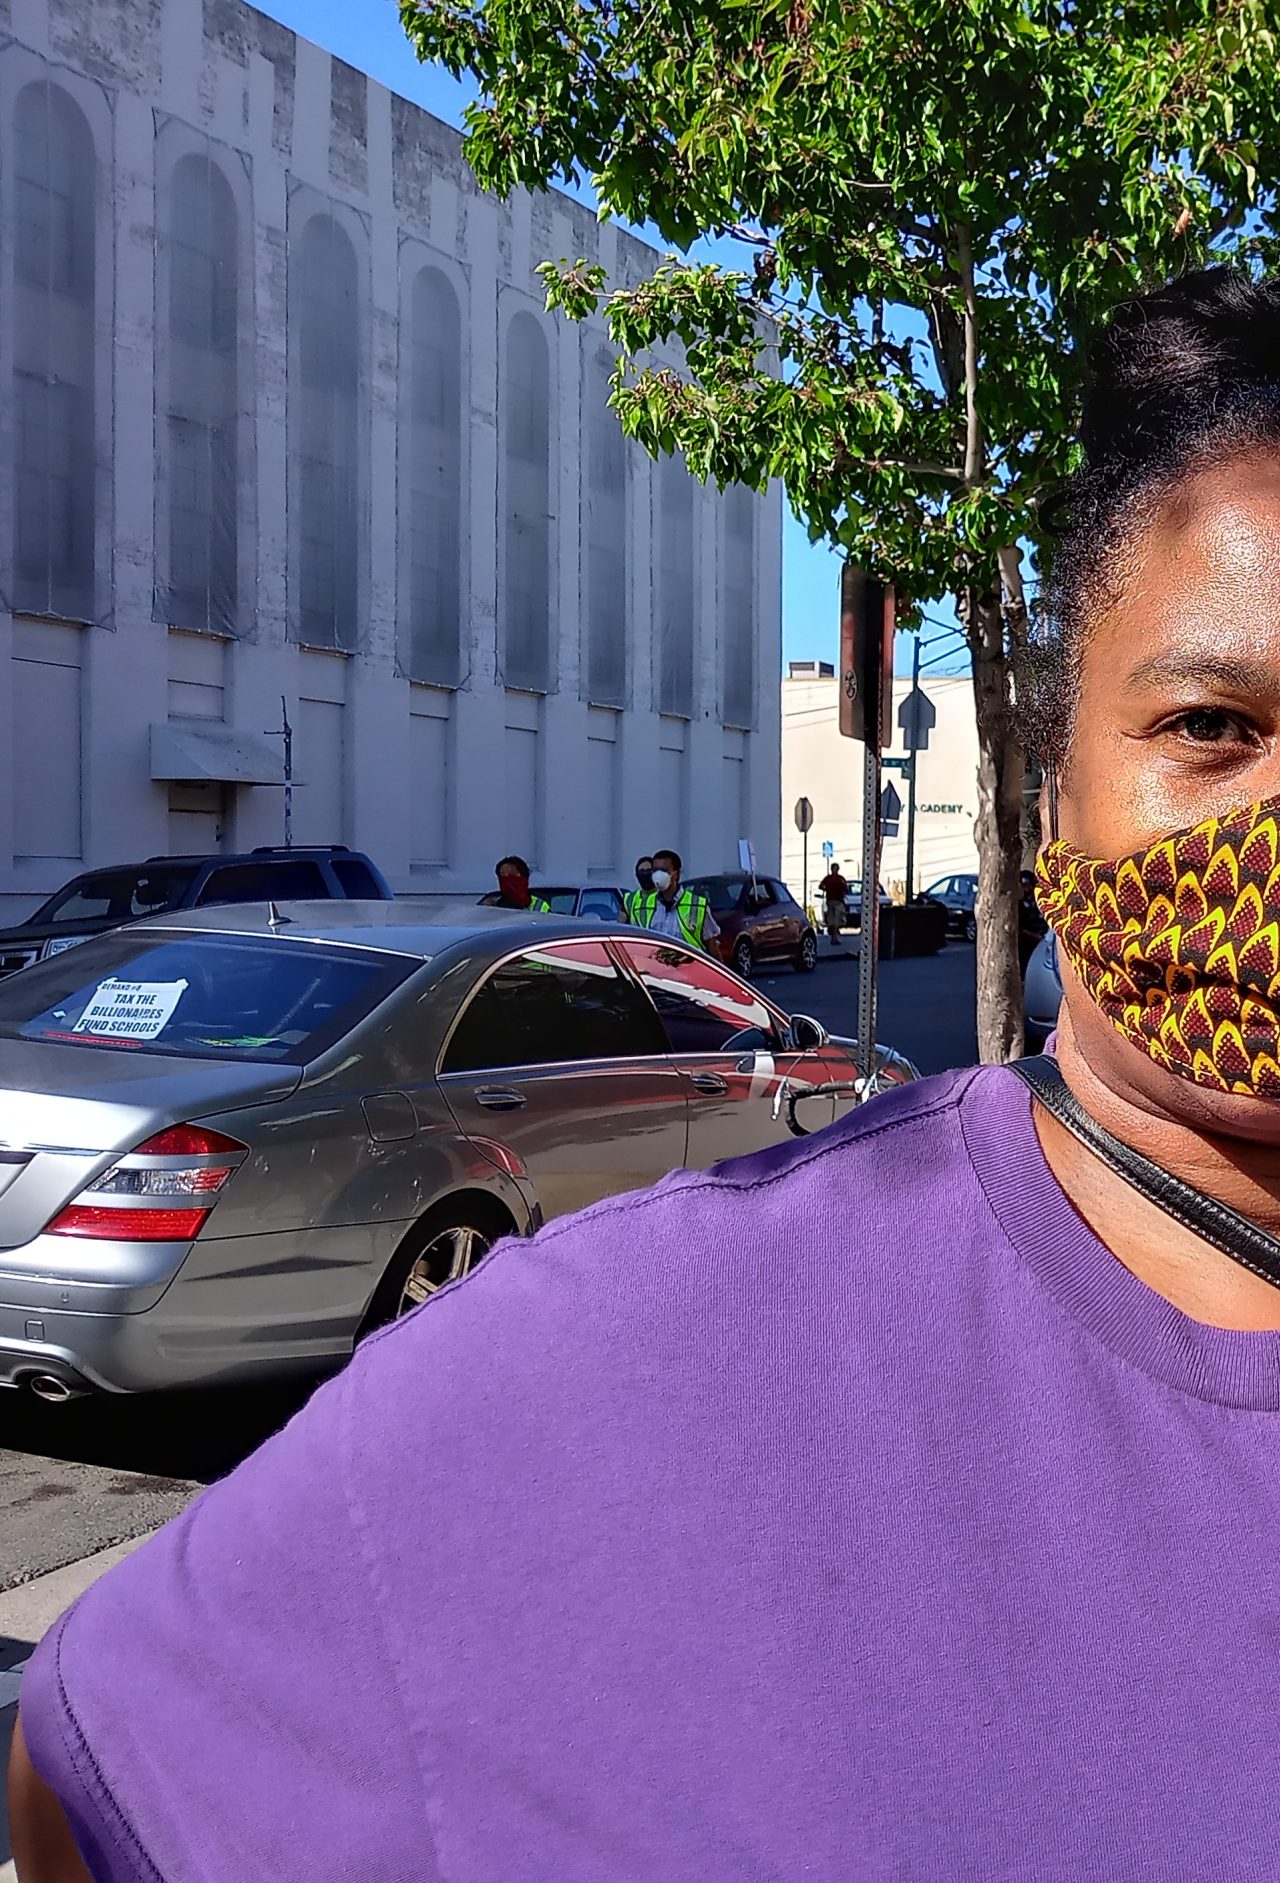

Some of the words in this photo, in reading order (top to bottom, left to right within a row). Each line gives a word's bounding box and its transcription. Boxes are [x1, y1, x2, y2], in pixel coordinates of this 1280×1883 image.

[101, 983, 131, 992] DEMAND
[114, 994, 136, 1005] TAX
[136, 995, 158, 1006] THE
[90, 1006, 164, 1020] BILLIONAIRES
[78, 1019, 109, 1031] FUND
[109, 1021, 160, 1033] SCHOOLS
